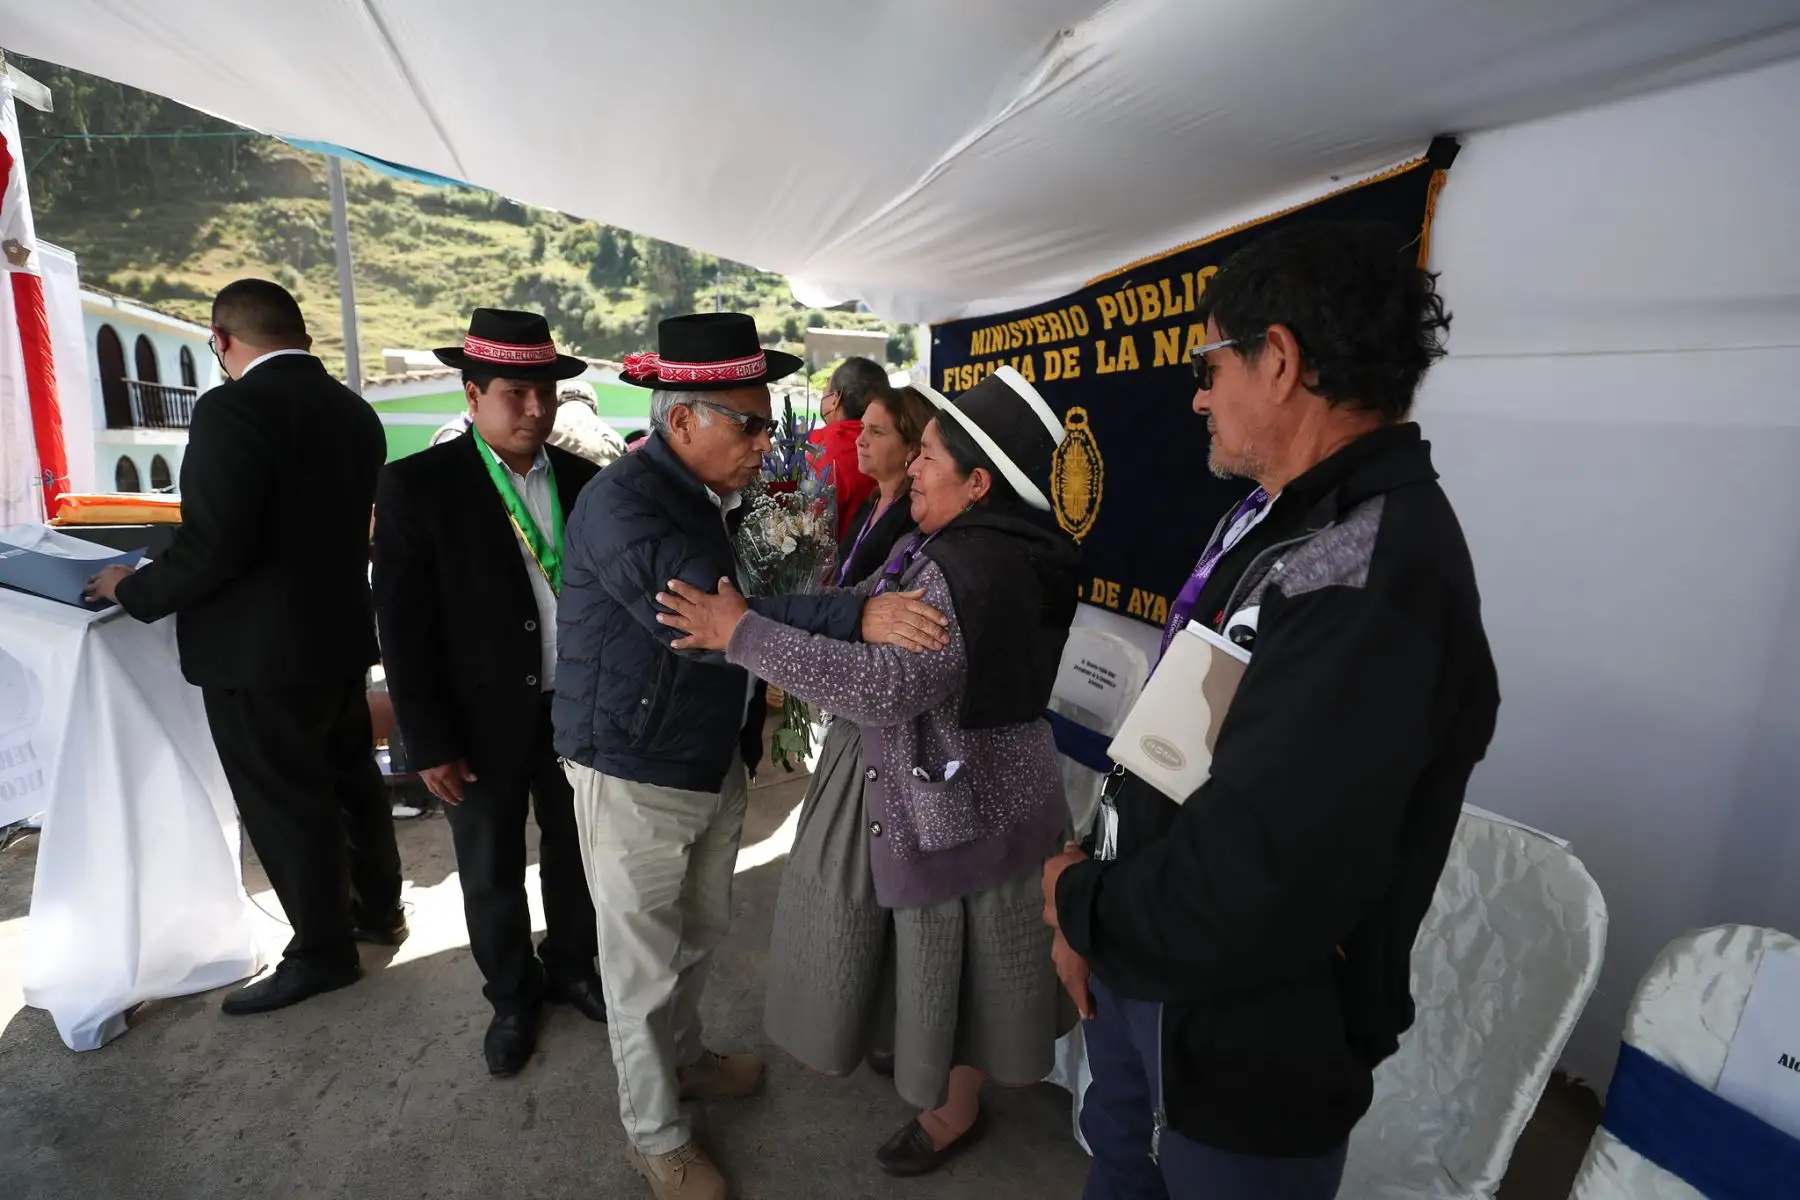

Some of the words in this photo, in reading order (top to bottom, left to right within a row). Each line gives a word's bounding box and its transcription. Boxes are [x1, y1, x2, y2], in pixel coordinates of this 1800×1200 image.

[970, 304, 1090, 356] MINISTERIO
[943, 356, 1036, 392] FISCAIA
[1044, 348, 1081, 382] DE
[1096, 335, 1140, 374] LA
[1090, 577, 1121, 609] DE
